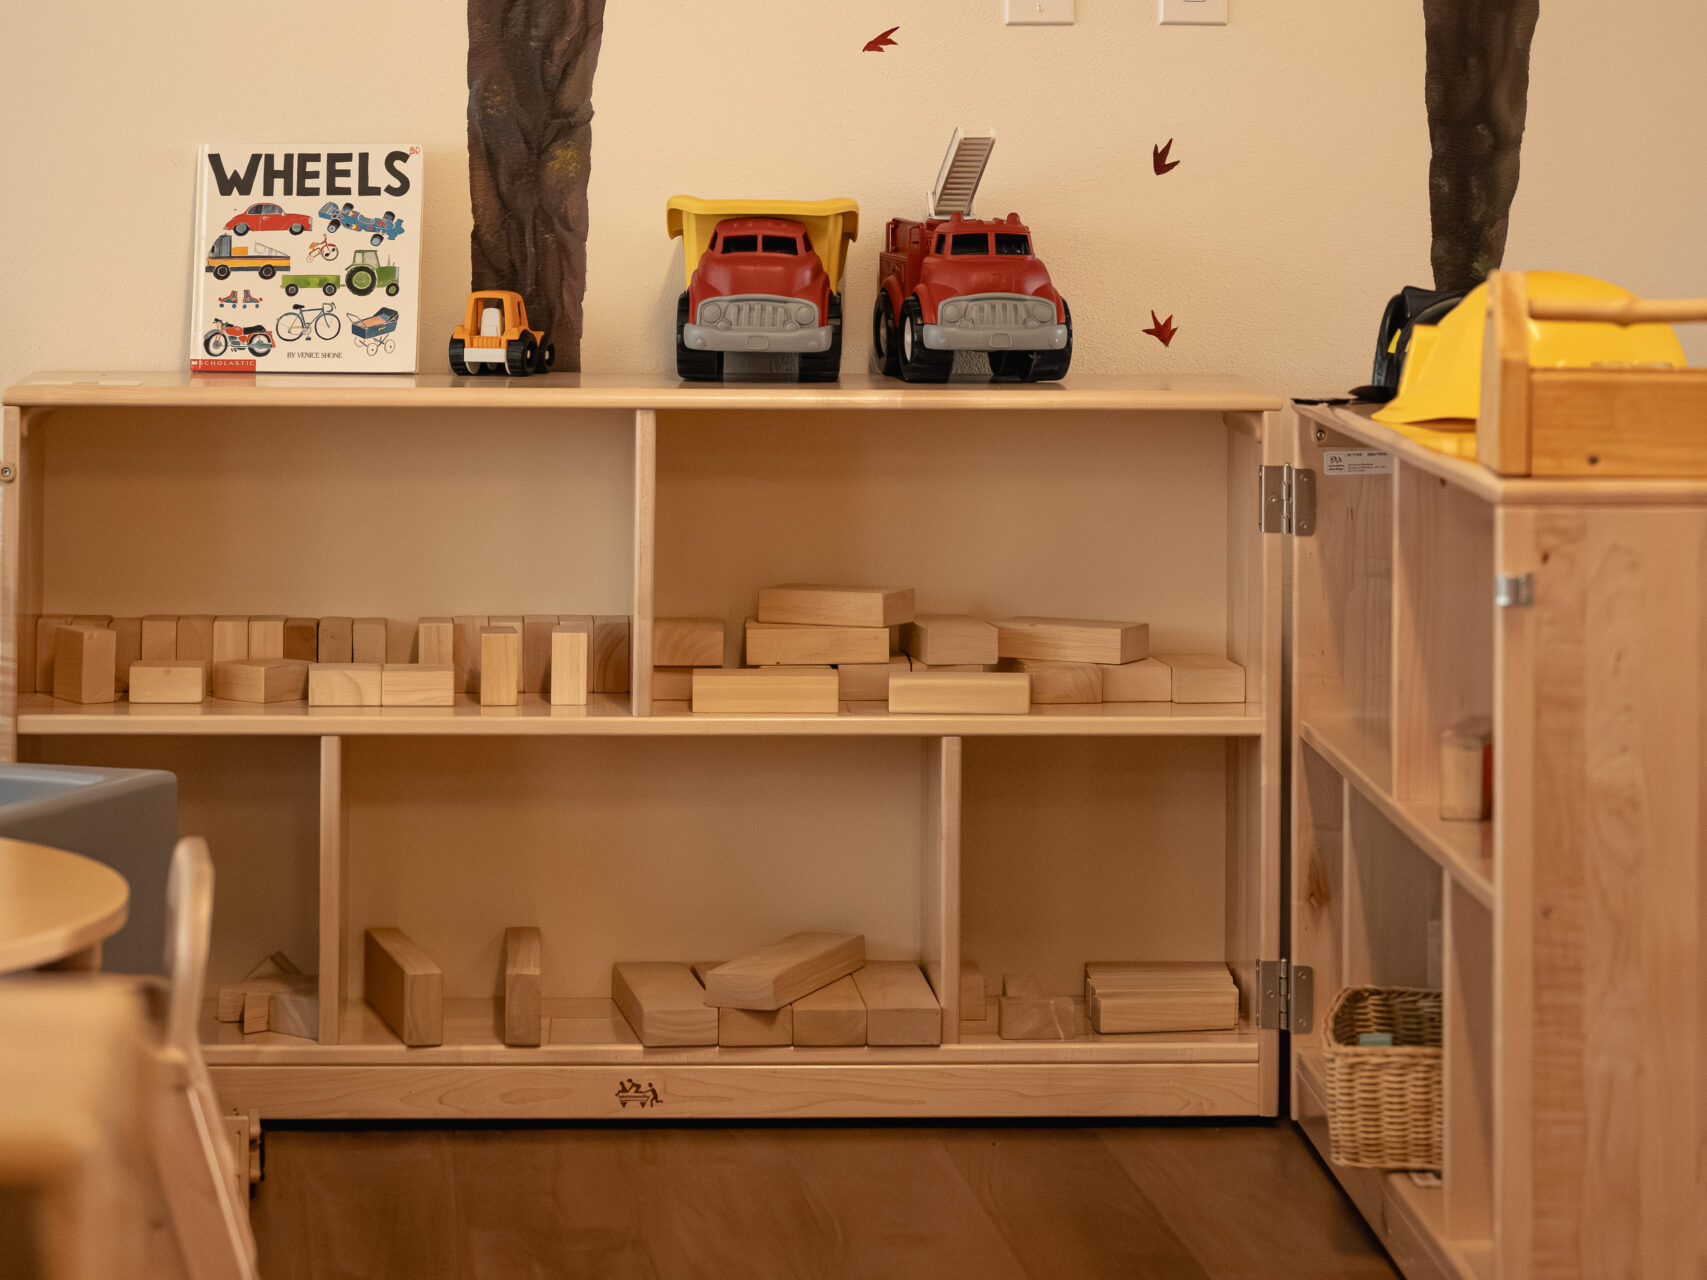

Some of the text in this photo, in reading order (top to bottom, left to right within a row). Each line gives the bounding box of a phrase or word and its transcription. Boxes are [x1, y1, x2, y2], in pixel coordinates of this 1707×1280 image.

[207, 150, 411, 197] WHEELS
[287, 351, 343, 359] BY VENICE SHONE
